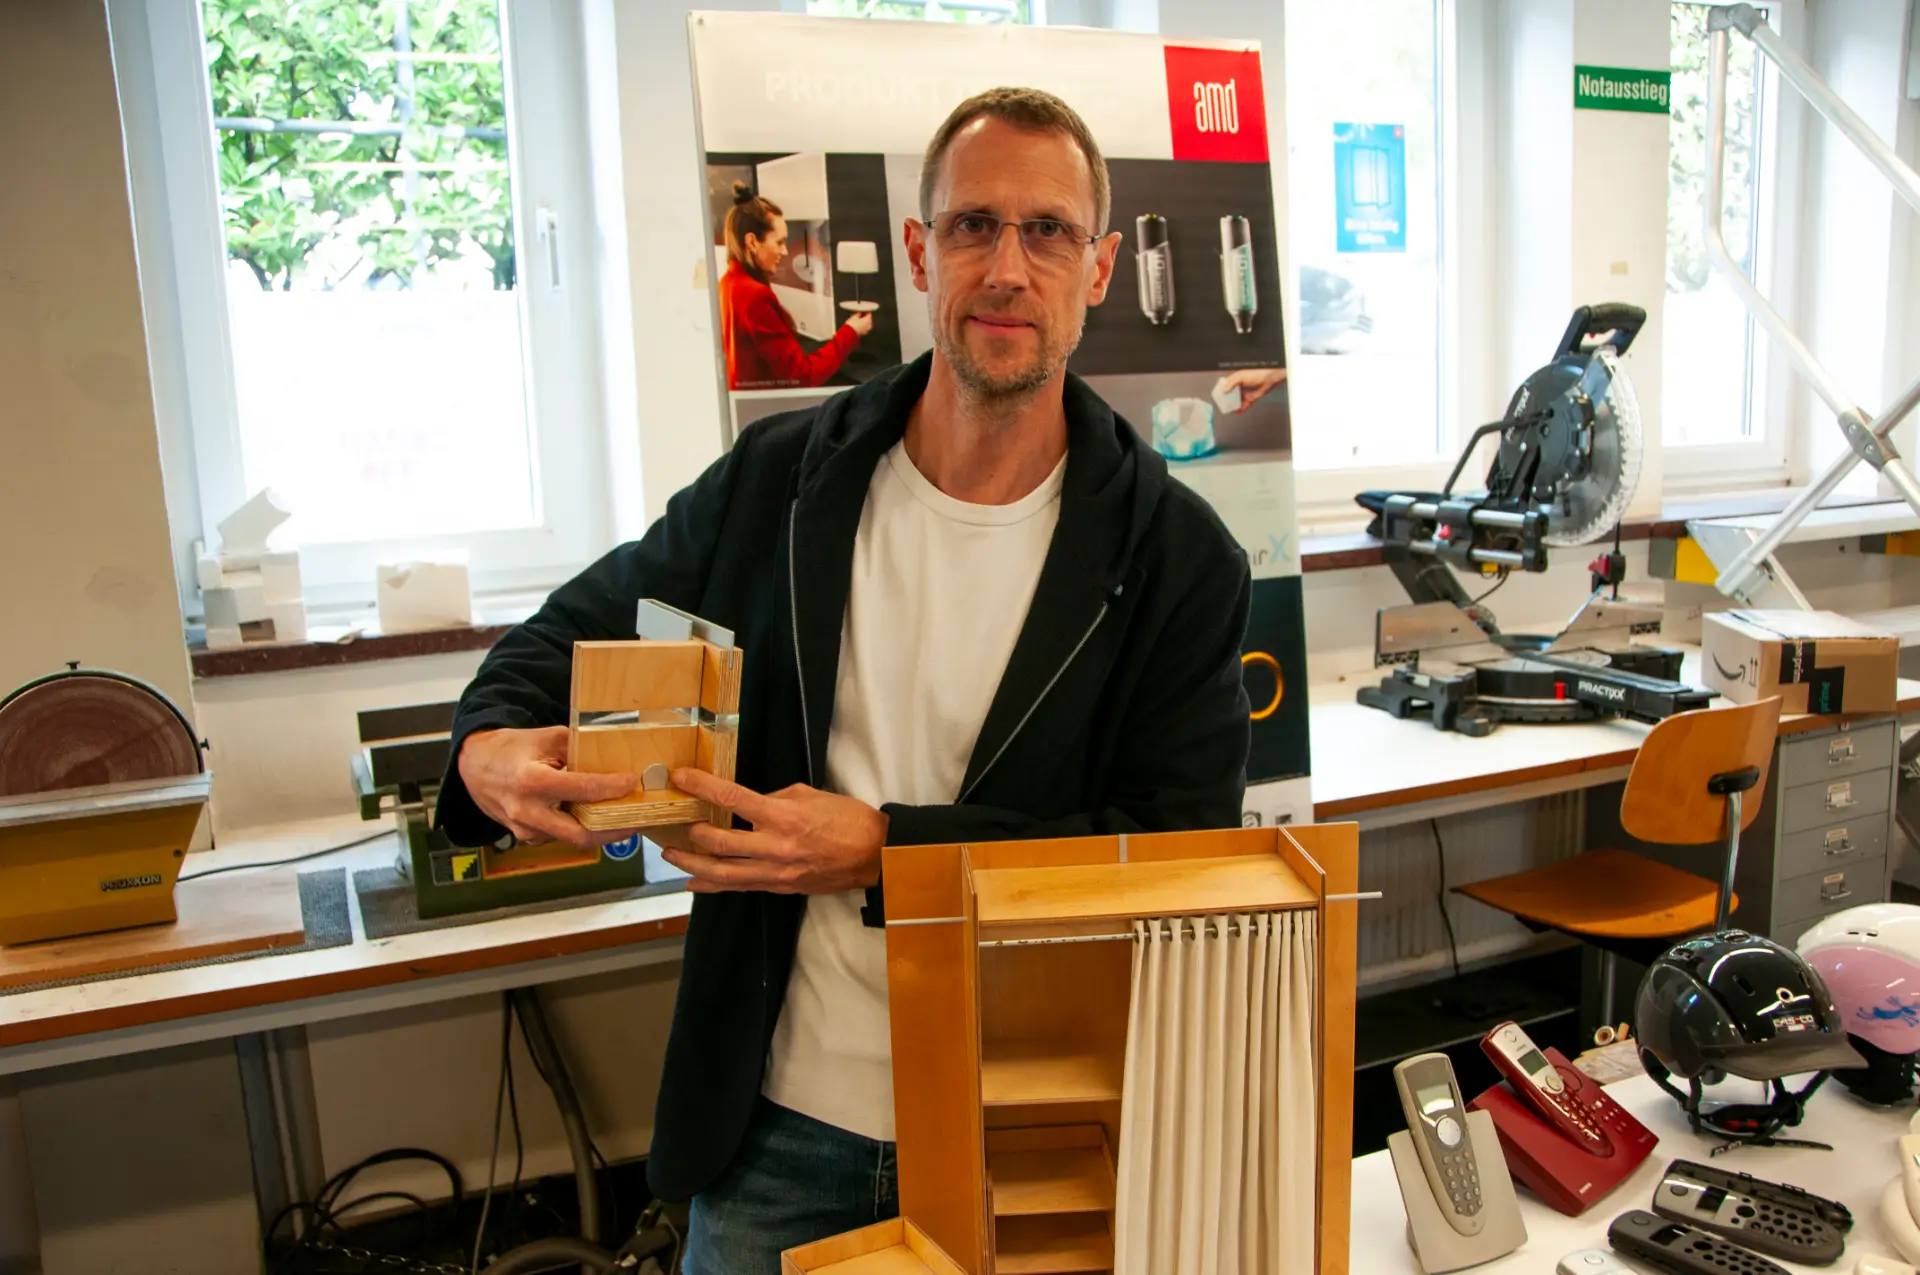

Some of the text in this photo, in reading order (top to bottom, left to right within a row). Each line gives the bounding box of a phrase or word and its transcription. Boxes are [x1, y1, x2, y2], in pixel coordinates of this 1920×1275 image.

[764, 71, 946, 105] PRODUKT
[1579, 73, 1667, 105] Notausstieg
[1193, 78, 1239, 134] amd
[102, 873, 161, 891] PROXXON
